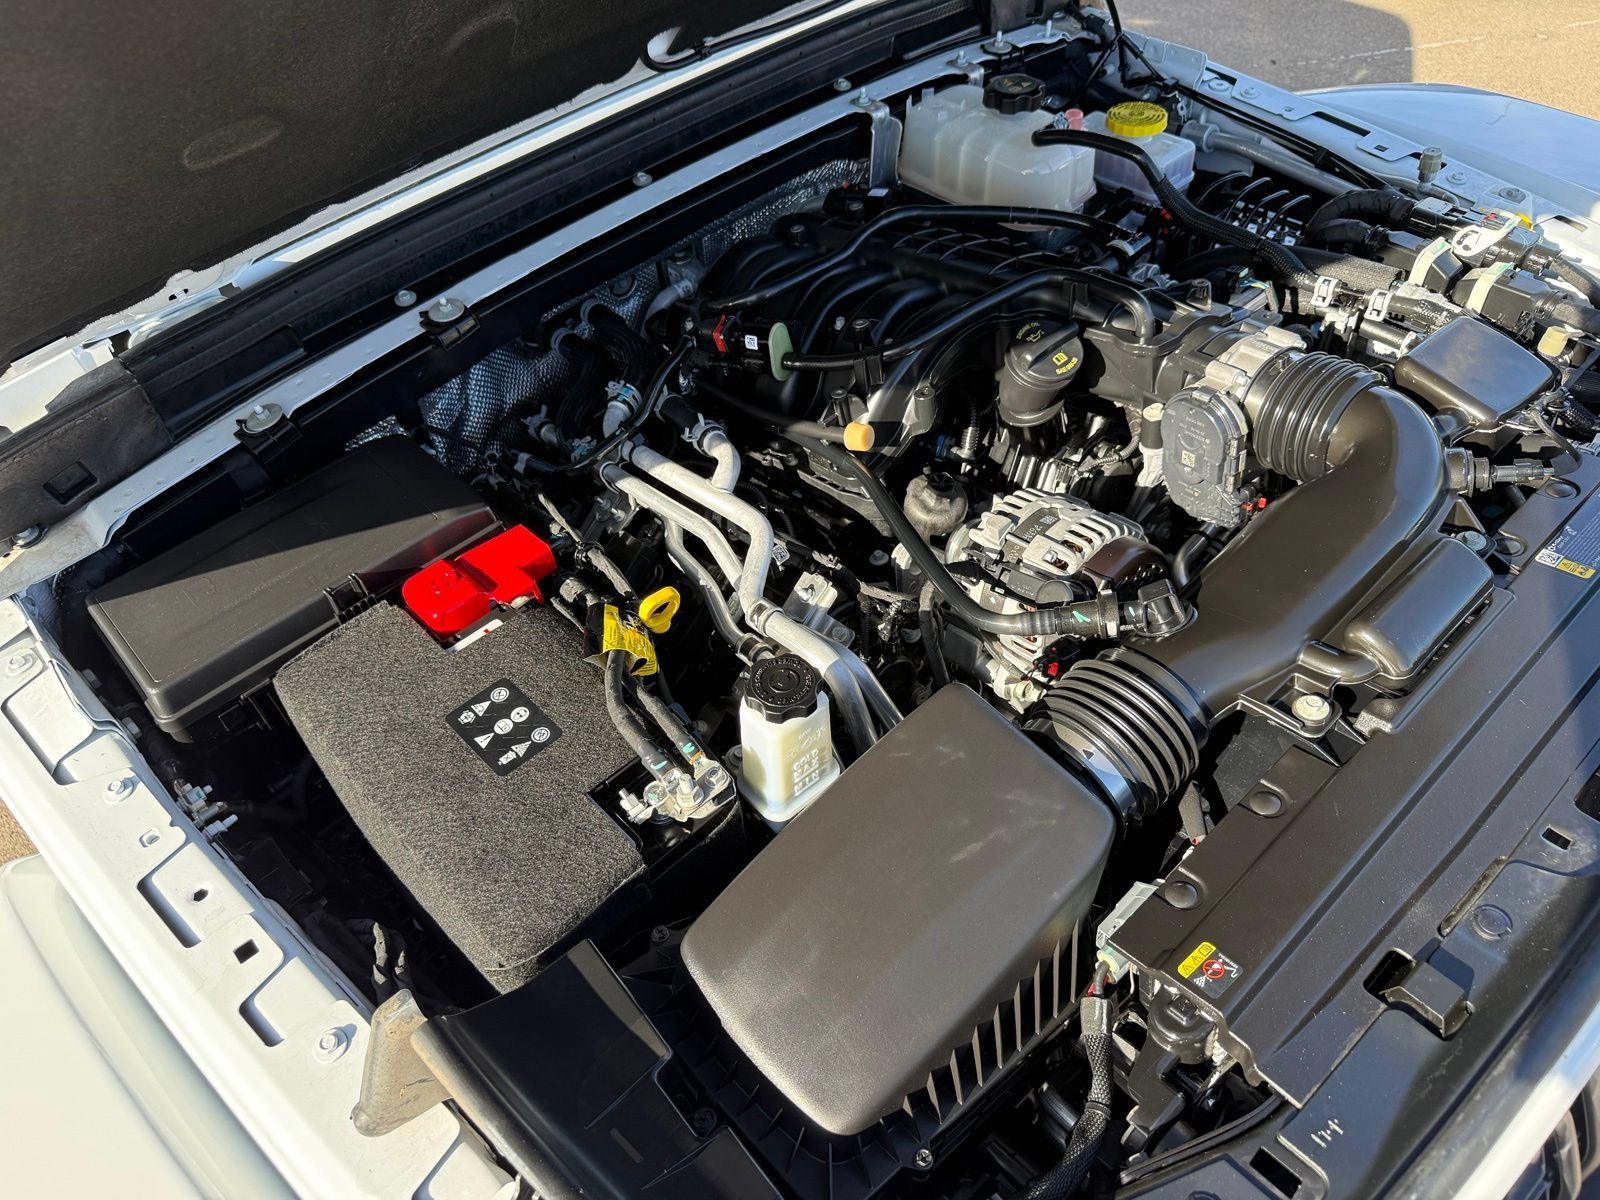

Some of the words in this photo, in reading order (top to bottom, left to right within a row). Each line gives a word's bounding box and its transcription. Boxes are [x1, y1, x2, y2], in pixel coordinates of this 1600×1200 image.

[1016, 324, 1031, 339] ENGINE
[793, 748, 819, 771] COLD
[793, 757, 819, 780] MAX
[794, 769, 820, 793] MIN
